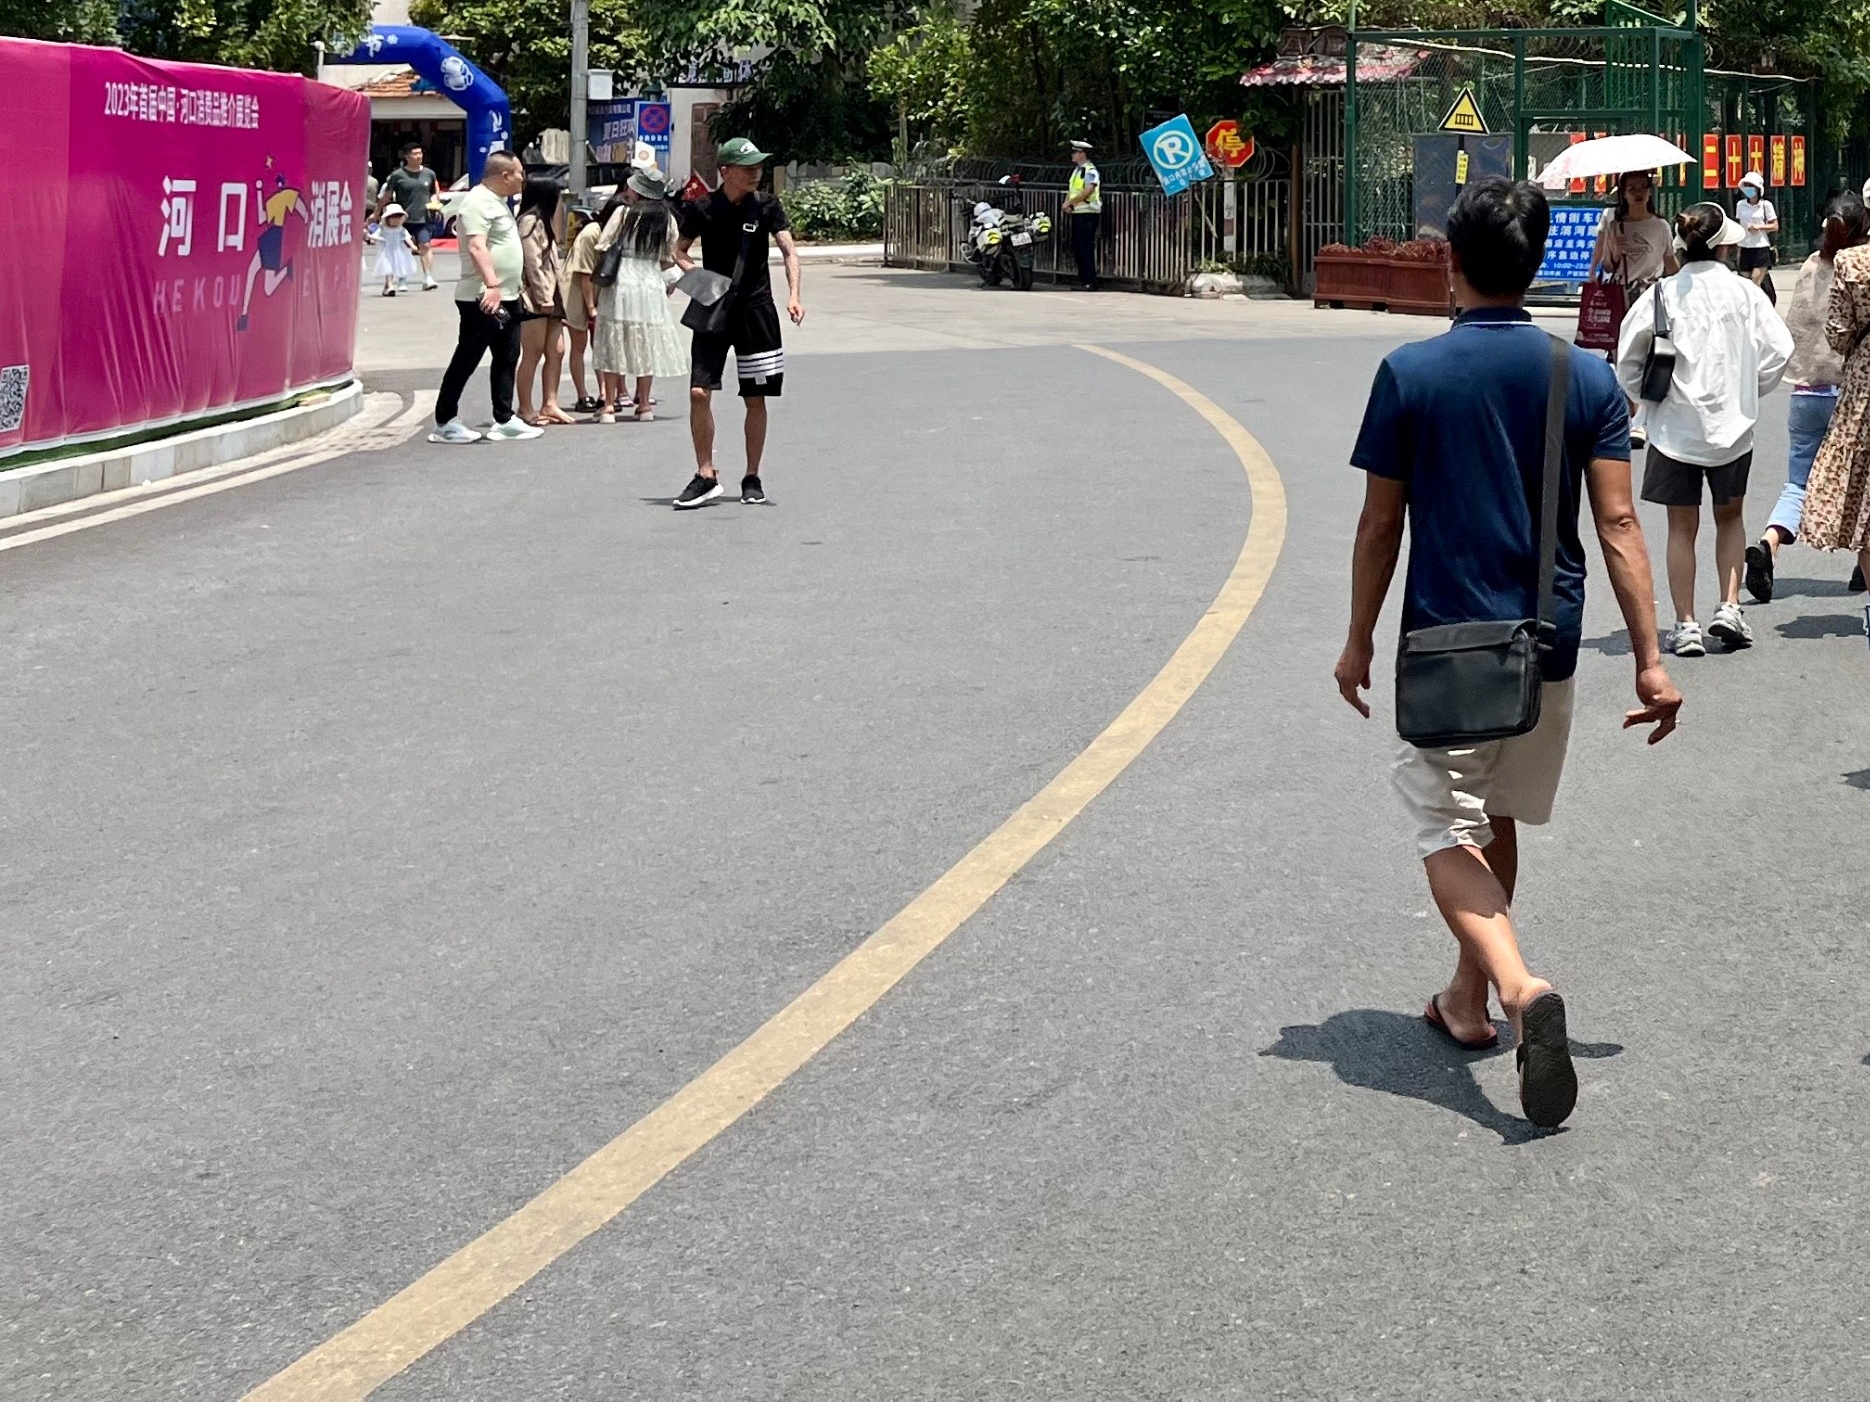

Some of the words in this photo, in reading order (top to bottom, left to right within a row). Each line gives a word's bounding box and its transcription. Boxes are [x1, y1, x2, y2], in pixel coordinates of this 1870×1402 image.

[1216, 127, 1246, 158] 停
[158, 175, 247, 257] 河口
[308, 180, 352, 248] 消展会
